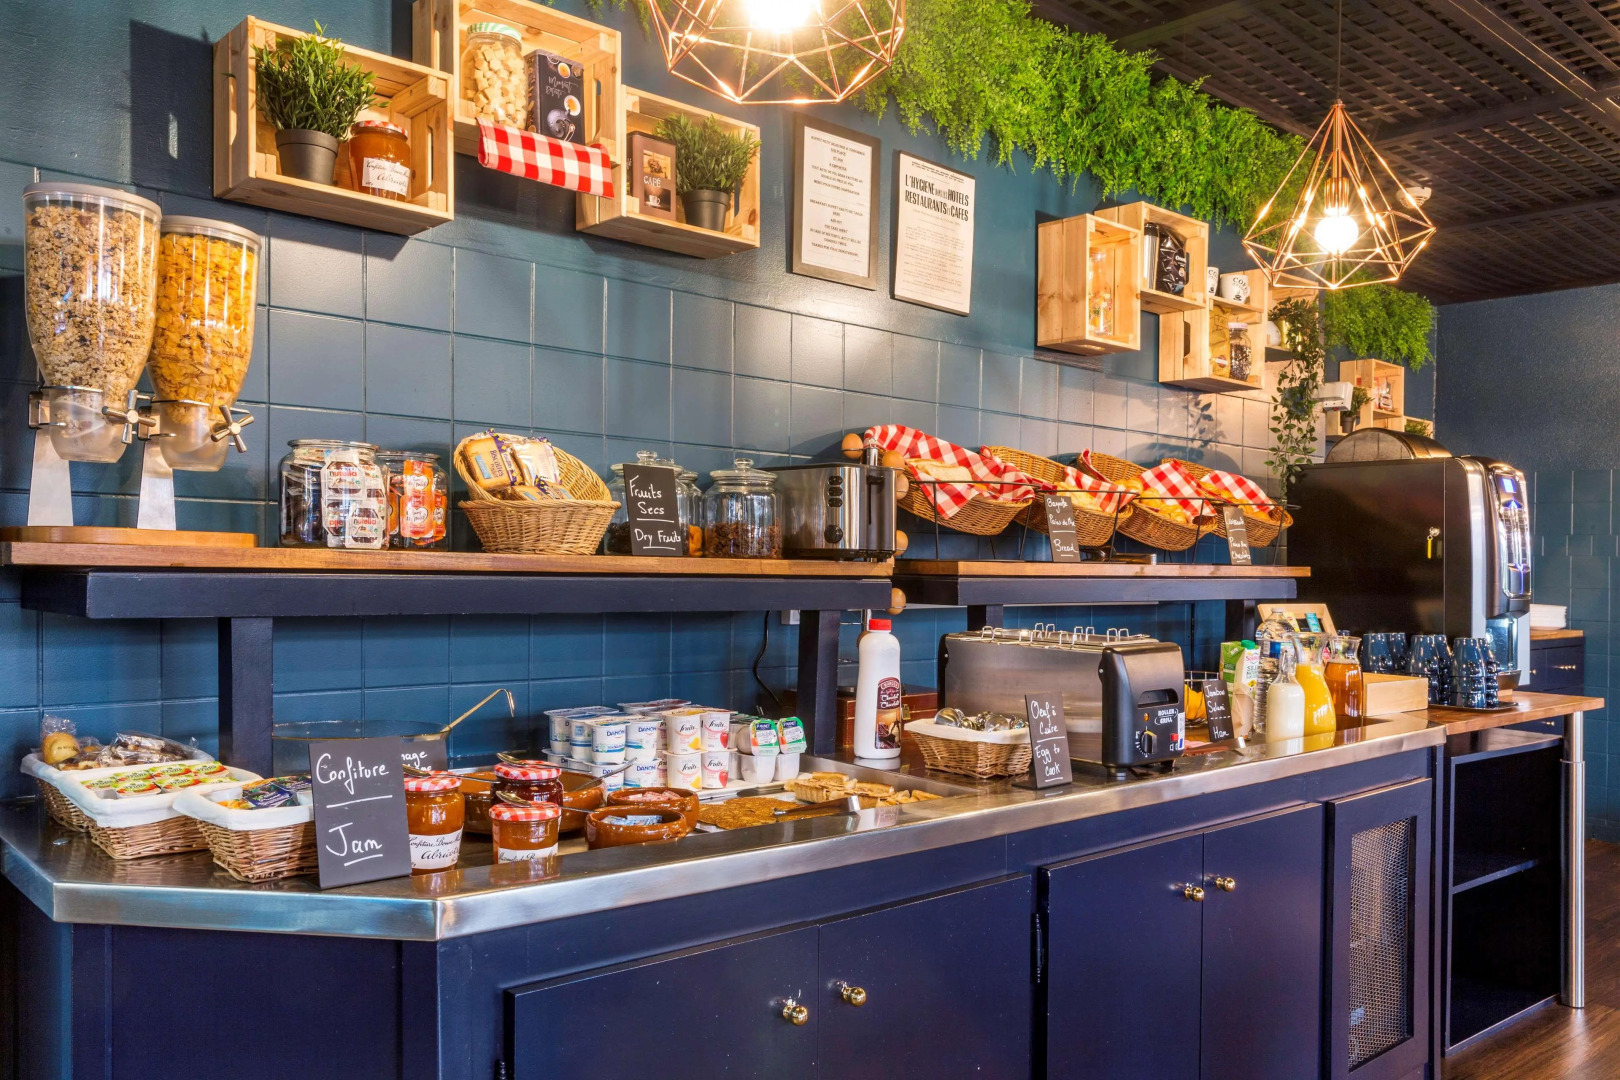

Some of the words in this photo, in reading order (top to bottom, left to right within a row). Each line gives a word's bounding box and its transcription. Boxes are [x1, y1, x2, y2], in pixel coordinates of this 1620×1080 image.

[905, 190, 947, 215] RESTAURANTS
[950, 205, 969, 222] CAFES
[948, 189, 969, 207] HOTELS
[629, 474, 663, 499] Fruits
[637, 501, 665, 515] Secs
[634, 528, 653, 547] Dry
[657, 530, 682, 543] Fruits
[1053, 538, 1078, 553] Bread
[1035, 745, 1052, 765] Egg
[316, 753, 390, 795] Confiture
[325, 822, 383, 856] Jam
